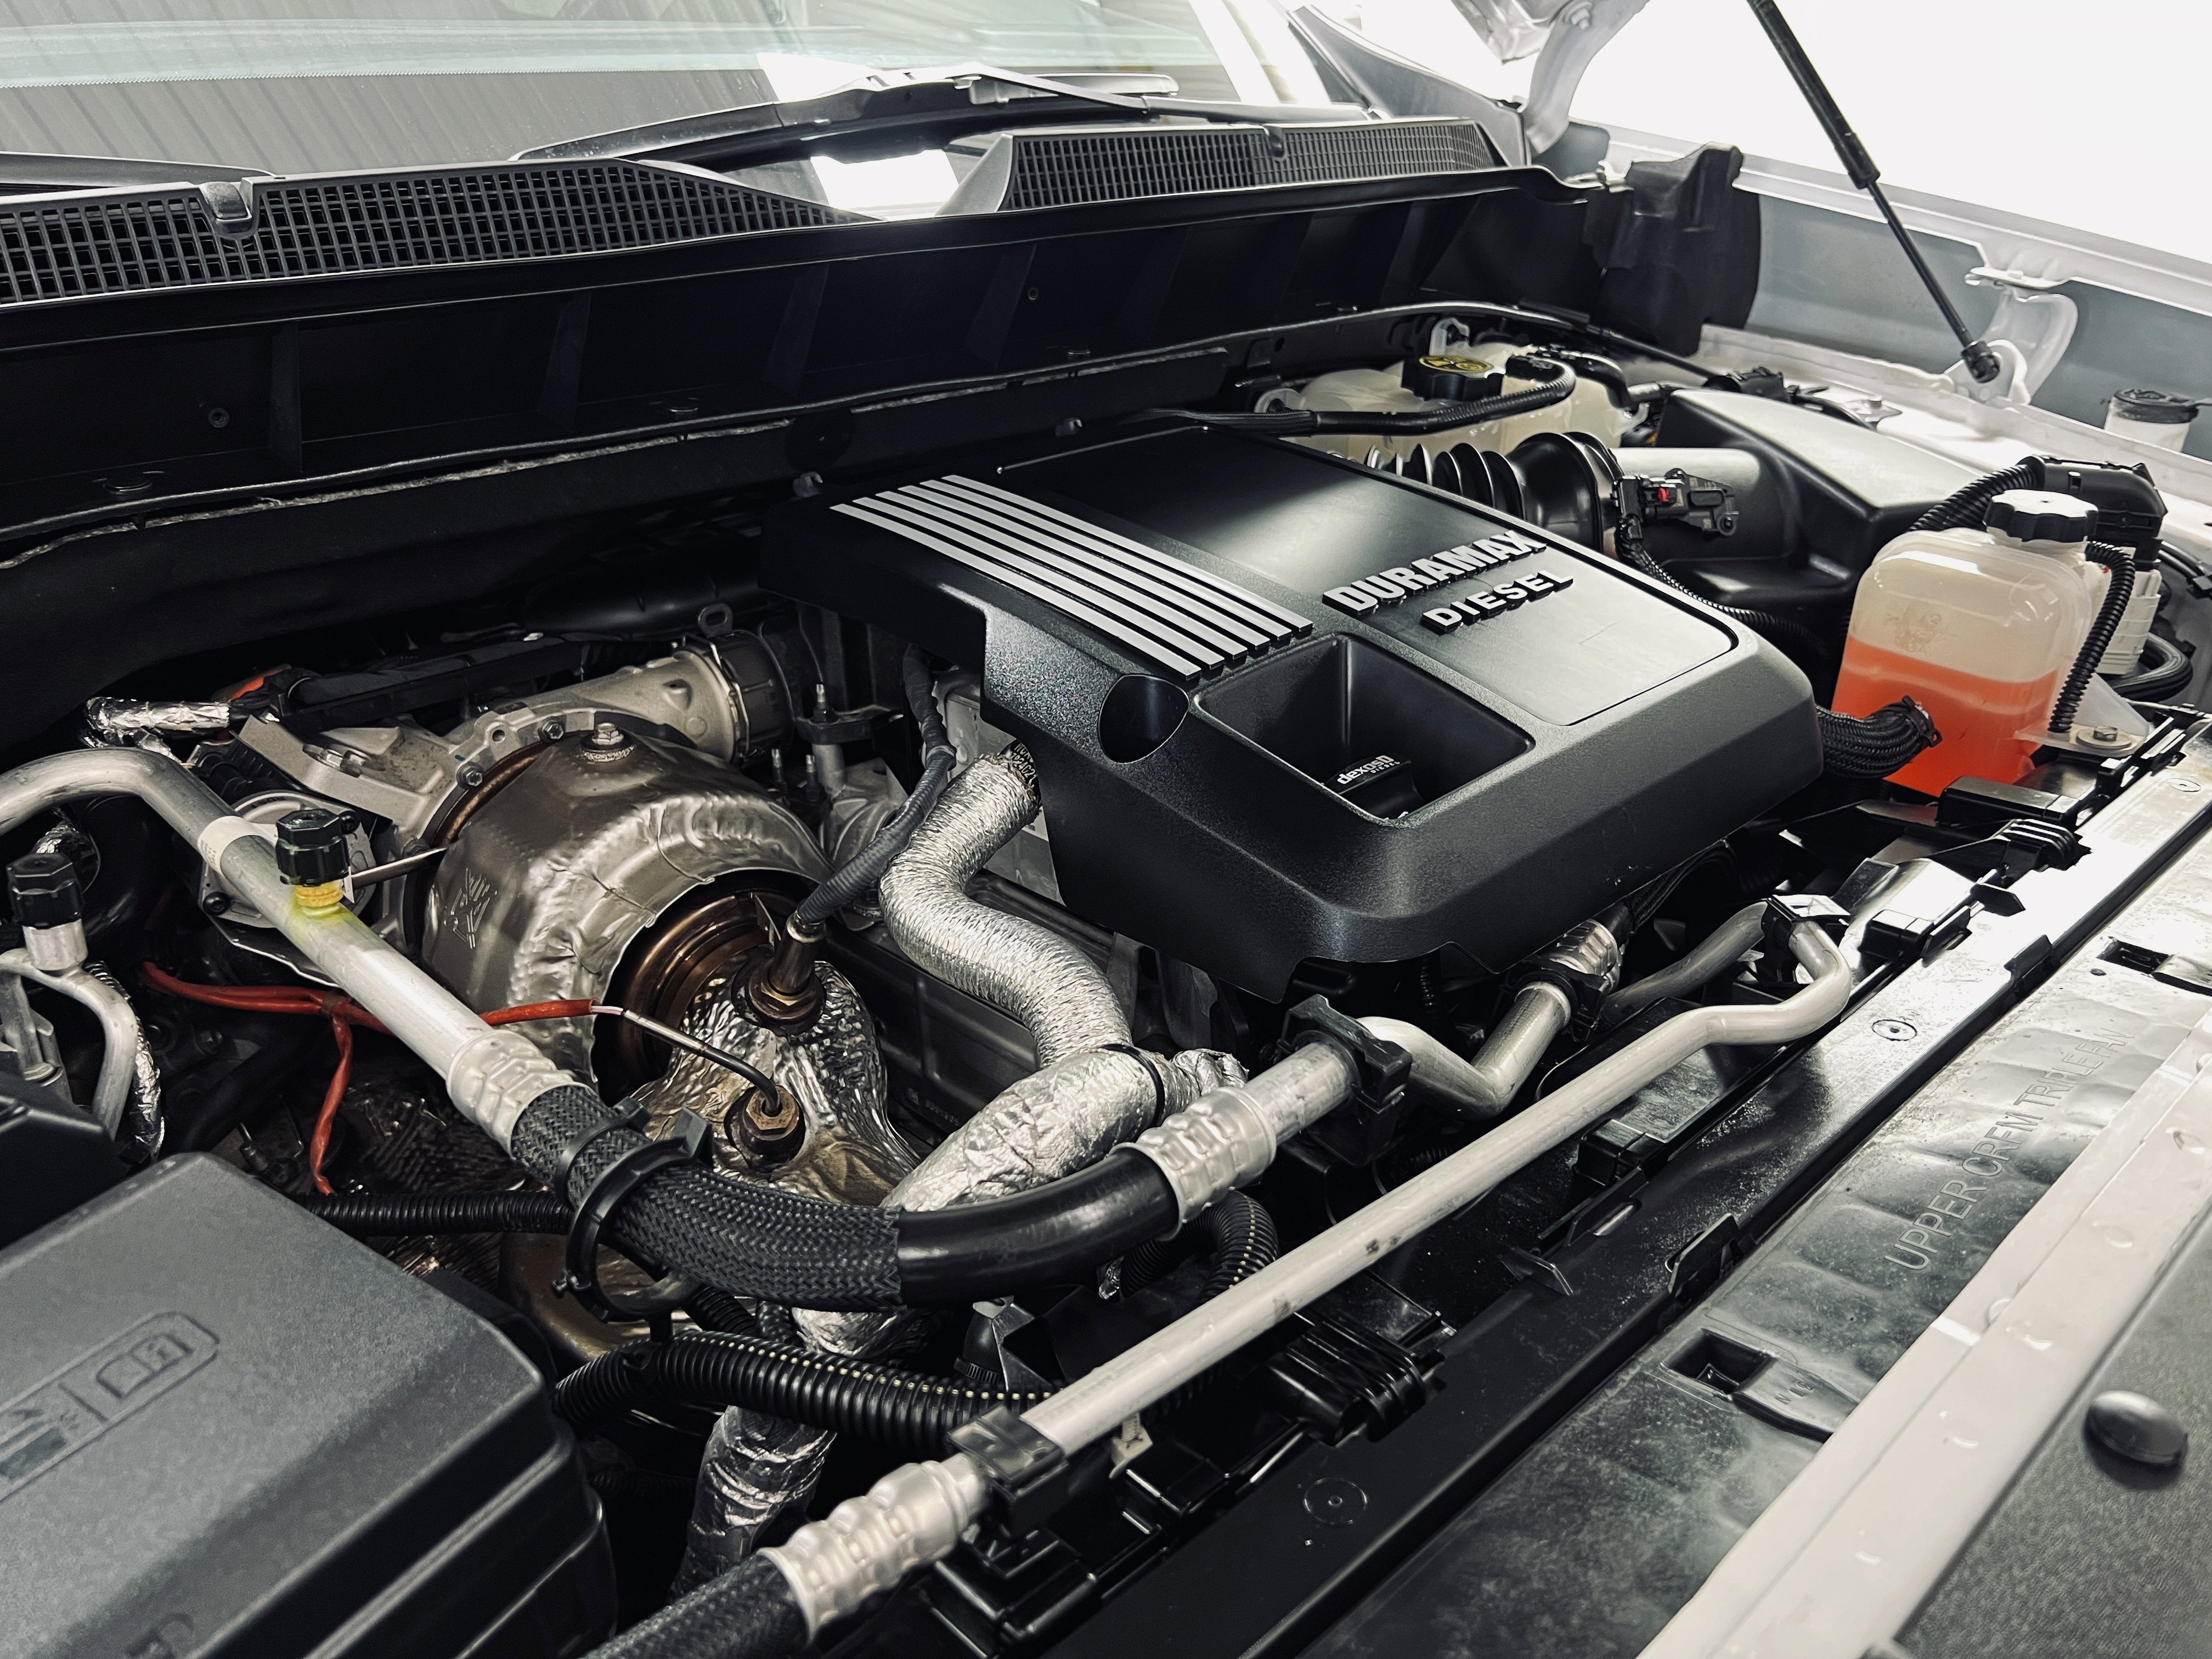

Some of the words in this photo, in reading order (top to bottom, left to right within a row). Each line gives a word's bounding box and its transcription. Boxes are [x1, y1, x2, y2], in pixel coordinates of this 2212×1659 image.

[1323, 529, 1547, 614] DURAMAX
[1421, 569, 1573, 631] DIESEL
[1883, 1179, 1988, 1271] UPPER
